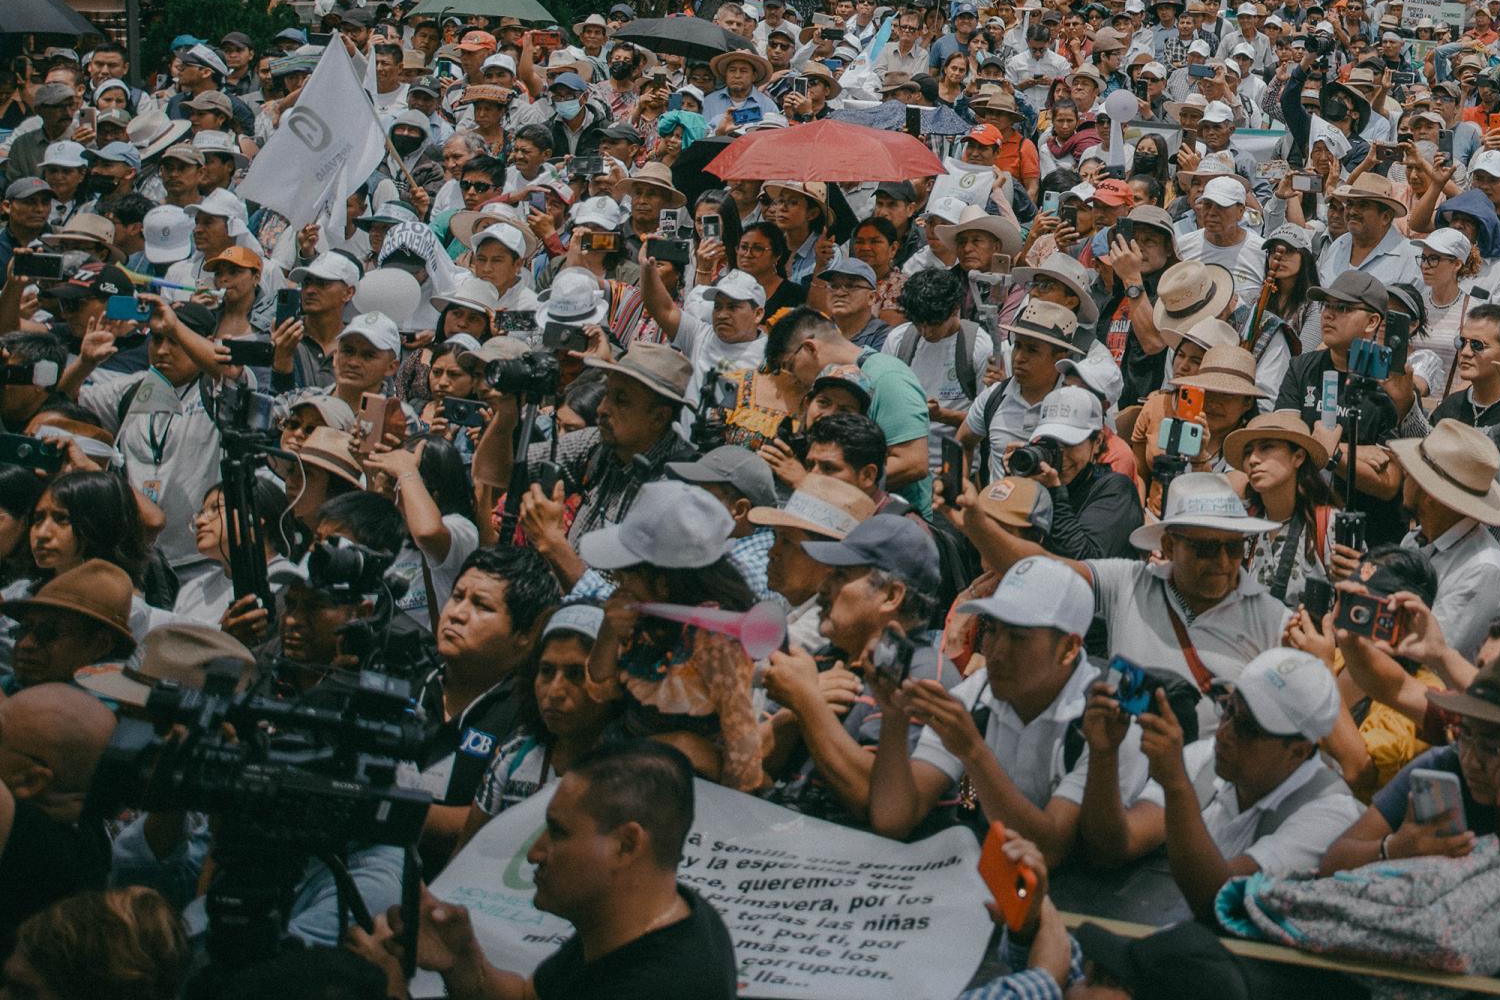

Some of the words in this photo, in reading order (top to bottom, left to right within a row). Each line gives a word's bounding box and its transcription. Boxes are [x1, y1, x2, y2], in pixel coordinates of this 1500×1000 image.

[460, 730, 493, 754] JCB
[332, 780, 363, 791] SONY
[711, 841, 799, 860] semilla
[807, 856, 852, 867] que
[857, 855, 962, 872] germina,
[706, 856, 728, 870] la
[736, 858, 861, 876] esperanza
[870, 872, 916, 882] que
[737, 875, 858, 894] queremos
[867, 880, 914, 890] que
[707, 892, 839, 914] primavera,
[849, 894, 888, 914] por
[897, 893, 935, 905] los
[736, 910, 807, 928] todas
[816, 916, 854, 931] las
[862, 913, 931, 932] niñas
[736, 939, 791, 954] más
[799, 944, 832, 958] de
[839, 950, 881, 963] los
[773, 928, 822, 942] por
[858, 939, 906, 951] por
